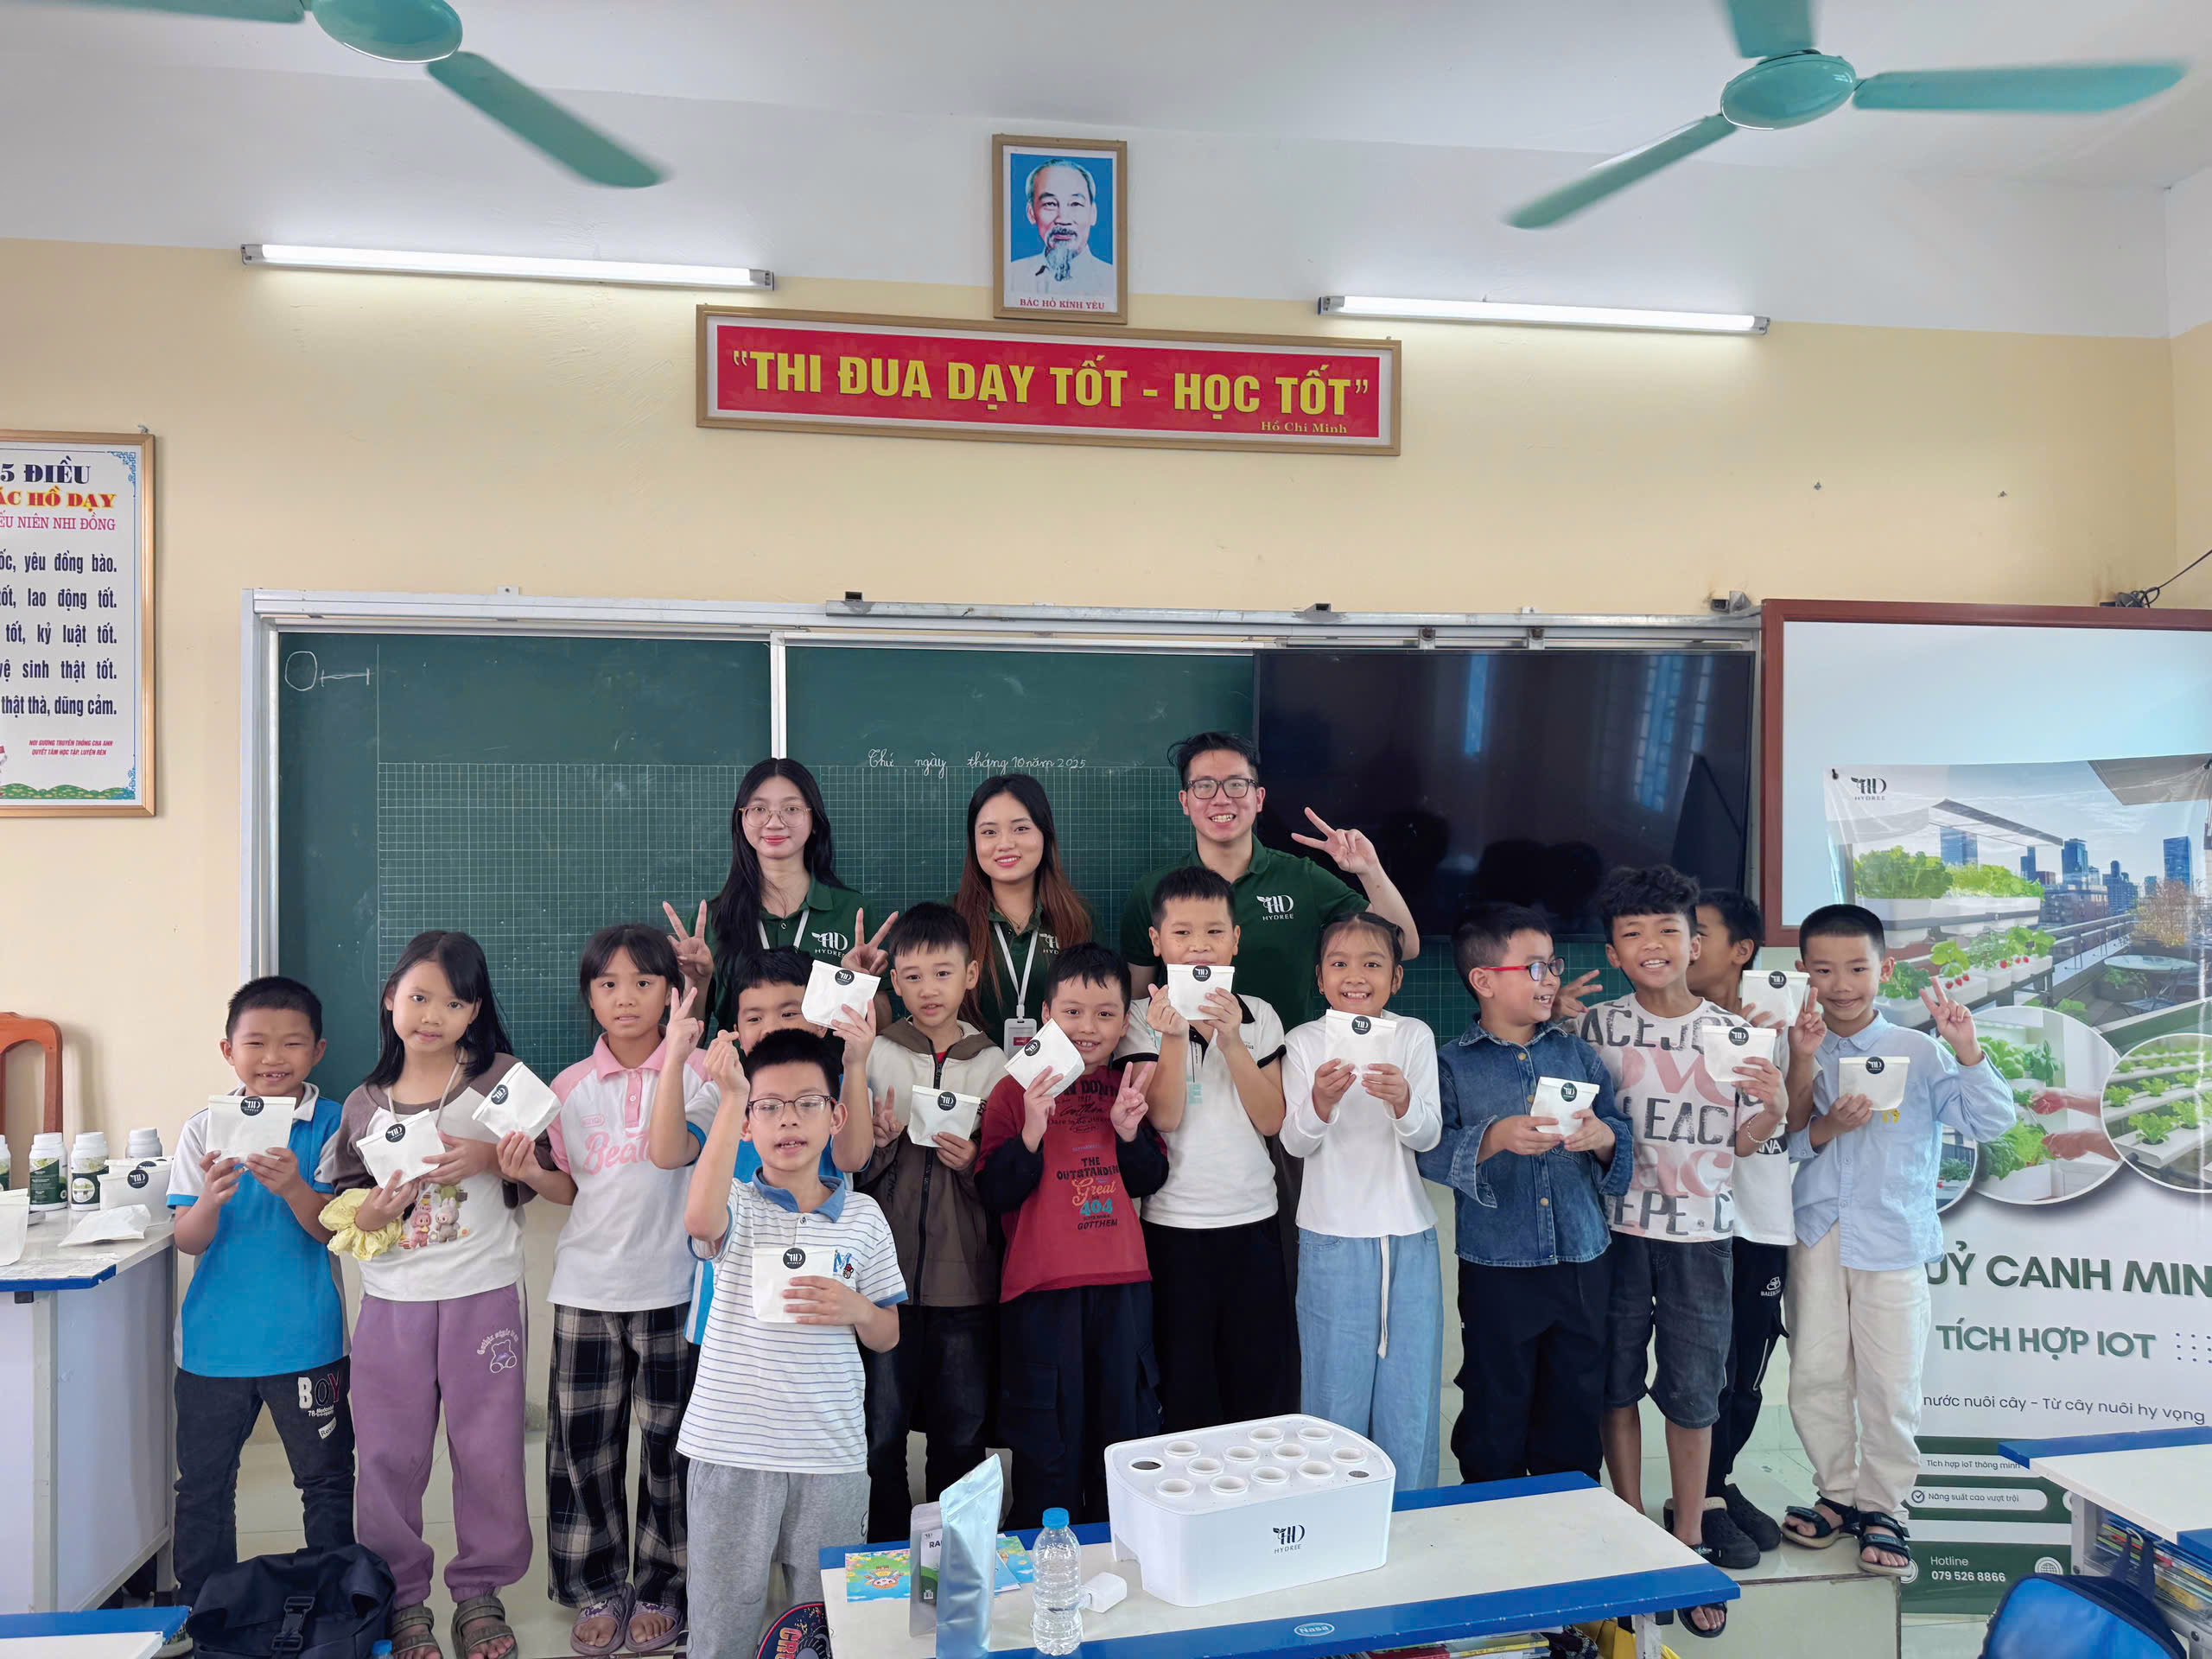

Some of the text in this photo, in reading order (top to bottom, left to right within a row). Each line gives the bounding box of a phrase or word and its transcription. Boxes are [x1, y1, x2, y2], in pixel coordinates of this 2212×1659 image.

[837, 356, 932, 399] ĐUA
[948, 362, 1034, 410] DẠY
[1050, 355, 1128, 407] TỐT
[1174, 372, 1260, 420] HỌC
[1313, 423, 1347, 434] Minh
[1, 455, 91, 484] 5 ĐIỀU
[28, 486, 61, 507] HỒ
[67, 493, 118, 512] DẠY
[17, 512, 49, 529] NIÊN
[53, 517, 77, 530] NHI
[80, 512, 116, 531] ĐỒNG
[24, 552, 46, 573] yêu
[54, 550, 84, 574] đồng
[92, 554, 117, 572] bào.
[0, 585, 117, 611] ốt, lao động tốt.
[6, 621, 117, 647] tốt, kỷ luật tốt.
[22, 660, 49, 678] sinh
[60, 660, 86, 683] thật
[97, 658, 117, 679] tốt.
[1, 694, 117, 718] thật thà, dũng cảm.
[915, 753, 947, 779] ngày
[967, 752, 1008, 775] tháng
[1057, 758, 1086, 769] 2025
[1057, 1164, 1120, 1180] OUTSTANDIN
[1082, 1157, 1100, 1166] THE
[1071, 1177, 1116, 1206] Great
[1080, 1198, 1114, 1217] 404
[1986, 1255, 2111, 1291] CANH
[1936, 1318, 2156, 1361] TÍCH HỢP IOT
[298, 1370, 340, 1409] BOY
[1923, 1394, 1960, 1408] nước
[1965, 1395, 1995, 1408] nuôi
[1999, 1397, 2026, 1412] cây
[2043, 1398, 2062, 1410] Từ
[2065, 1399, 2093, 1414] cây
[2098, 1402, 2133, 1414] nuôi
[2138, 1404, 2158, 1420] hy
[2162, 1408, 2205, 1426] vọng
[1274, 1544, 1302, 1554] HYDREE
[1930, 1555, 1969, 1566] Hotline
[1931, 1571, 2006, 1582] 079 526 8866
